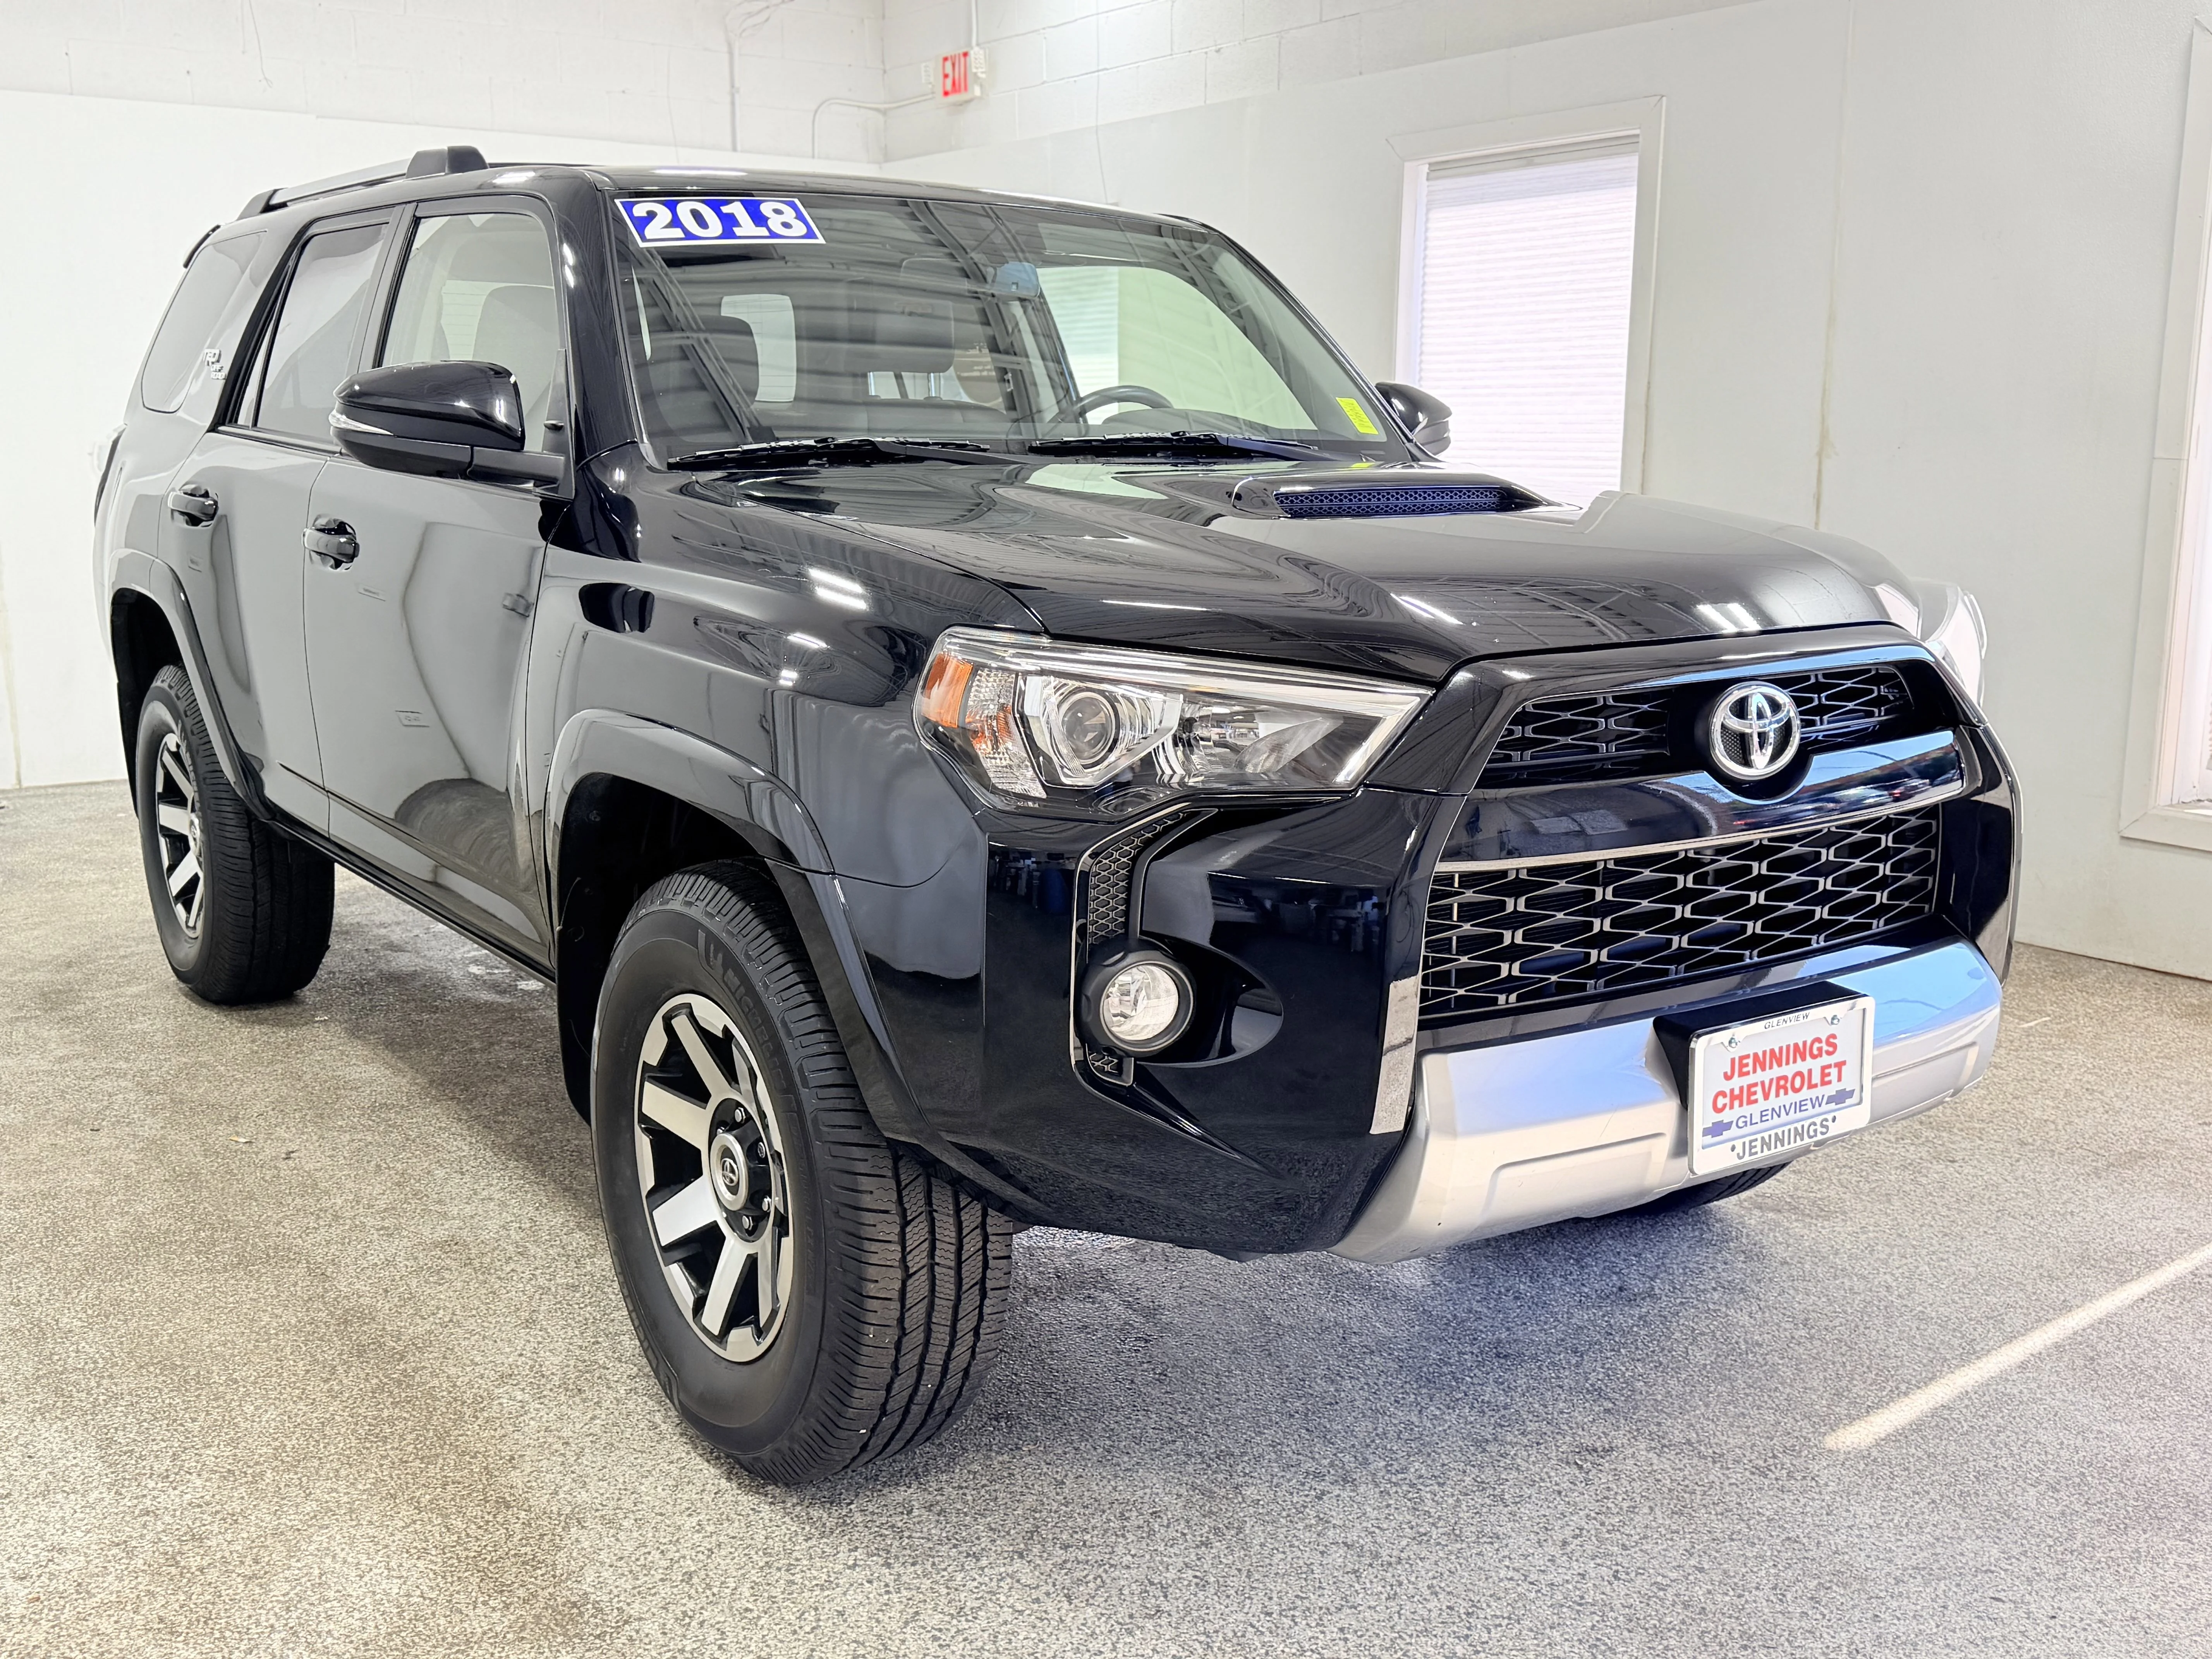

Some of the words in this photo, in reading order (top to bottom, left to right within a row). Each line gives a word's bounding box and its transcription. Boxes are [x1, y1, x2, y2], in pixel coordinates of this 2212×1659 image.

[942, 51, 969, 97] EXIT
[632, 201, 807, 239] 2018
[1764, 1012, 1810, 1029] GLENVIEW
[1723, 1033, 1838, 1081] JENNINGS
[1712, 1060, 1847, 1114] CHEVROLET
[1735, 1094, 1827, 1129] GLENVIEW
[1736, 1118, 1829, 1160] JENNINGS
